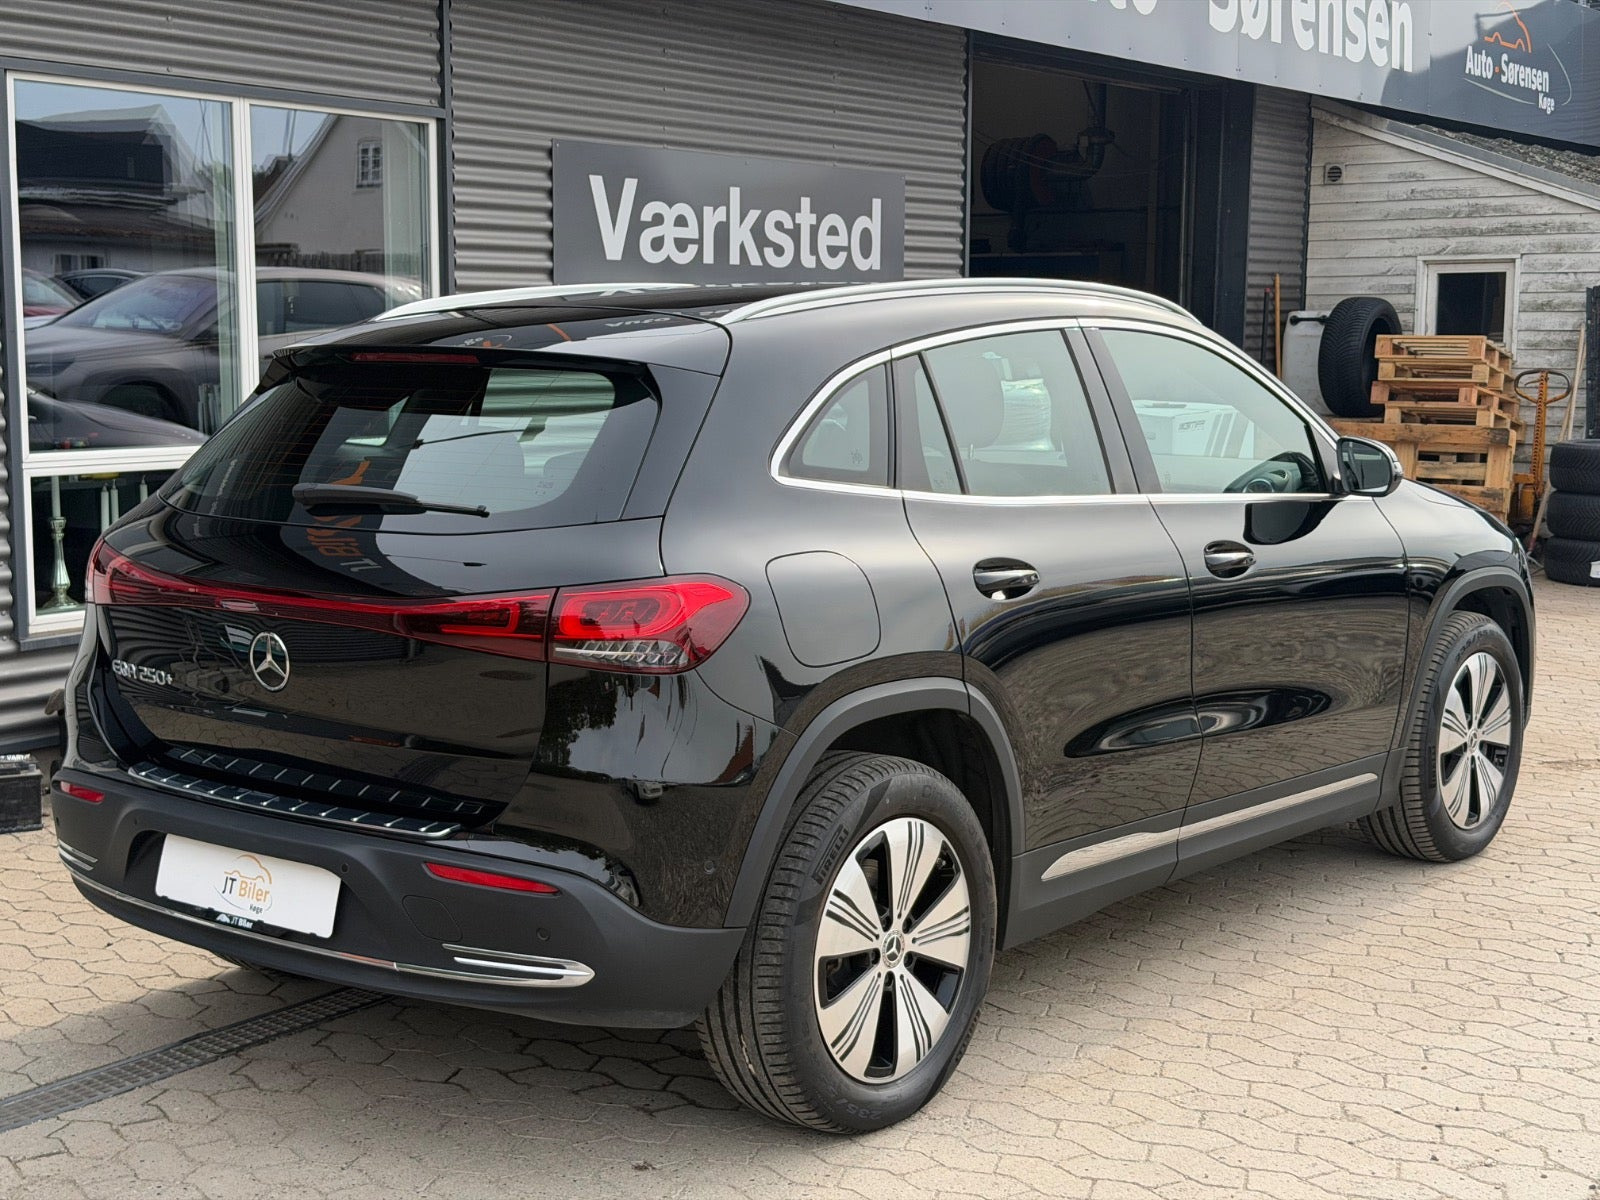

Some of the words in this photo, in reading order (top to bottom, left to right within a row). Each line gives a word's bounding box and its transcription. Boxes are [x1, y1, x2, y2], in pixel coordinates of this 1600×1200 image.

[1465, 45, 1494, 79] Auto
[1501, 53, 1550, 93] Sørensen
[589, 174, 882, 271] Værksted
[112, 659, 137, 679] EQA
[138, 665, 173, 685] 250+
[811, 825, 849, 885] PIRELLI
[222, 876, 237, 895] JT
[239, 880, 270, 903] Biler
[230, 916, 239, 926] JT
[238, 916, 254, 929] Biler
